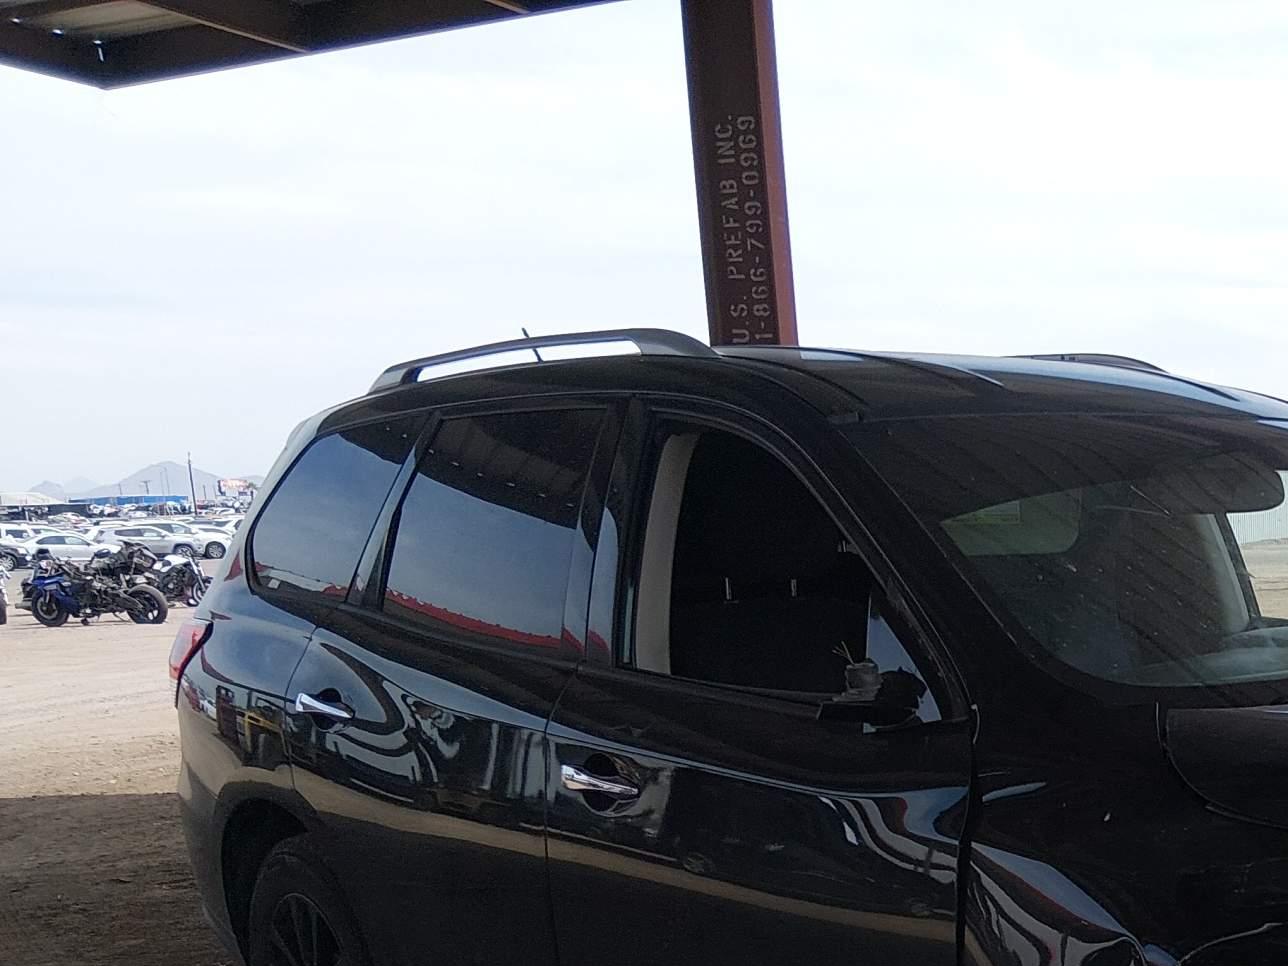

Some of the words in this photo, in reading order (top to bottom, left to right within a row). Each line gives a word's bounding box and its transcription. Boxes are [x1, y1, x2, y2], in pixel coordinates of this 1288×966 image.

[714, 115, 736, 164] INC.
[719, 179, 746, 279] PREFAB
[737, 115, 773, 340] 1-866-799-0969
[731, 296, 750, 344] U.S.
